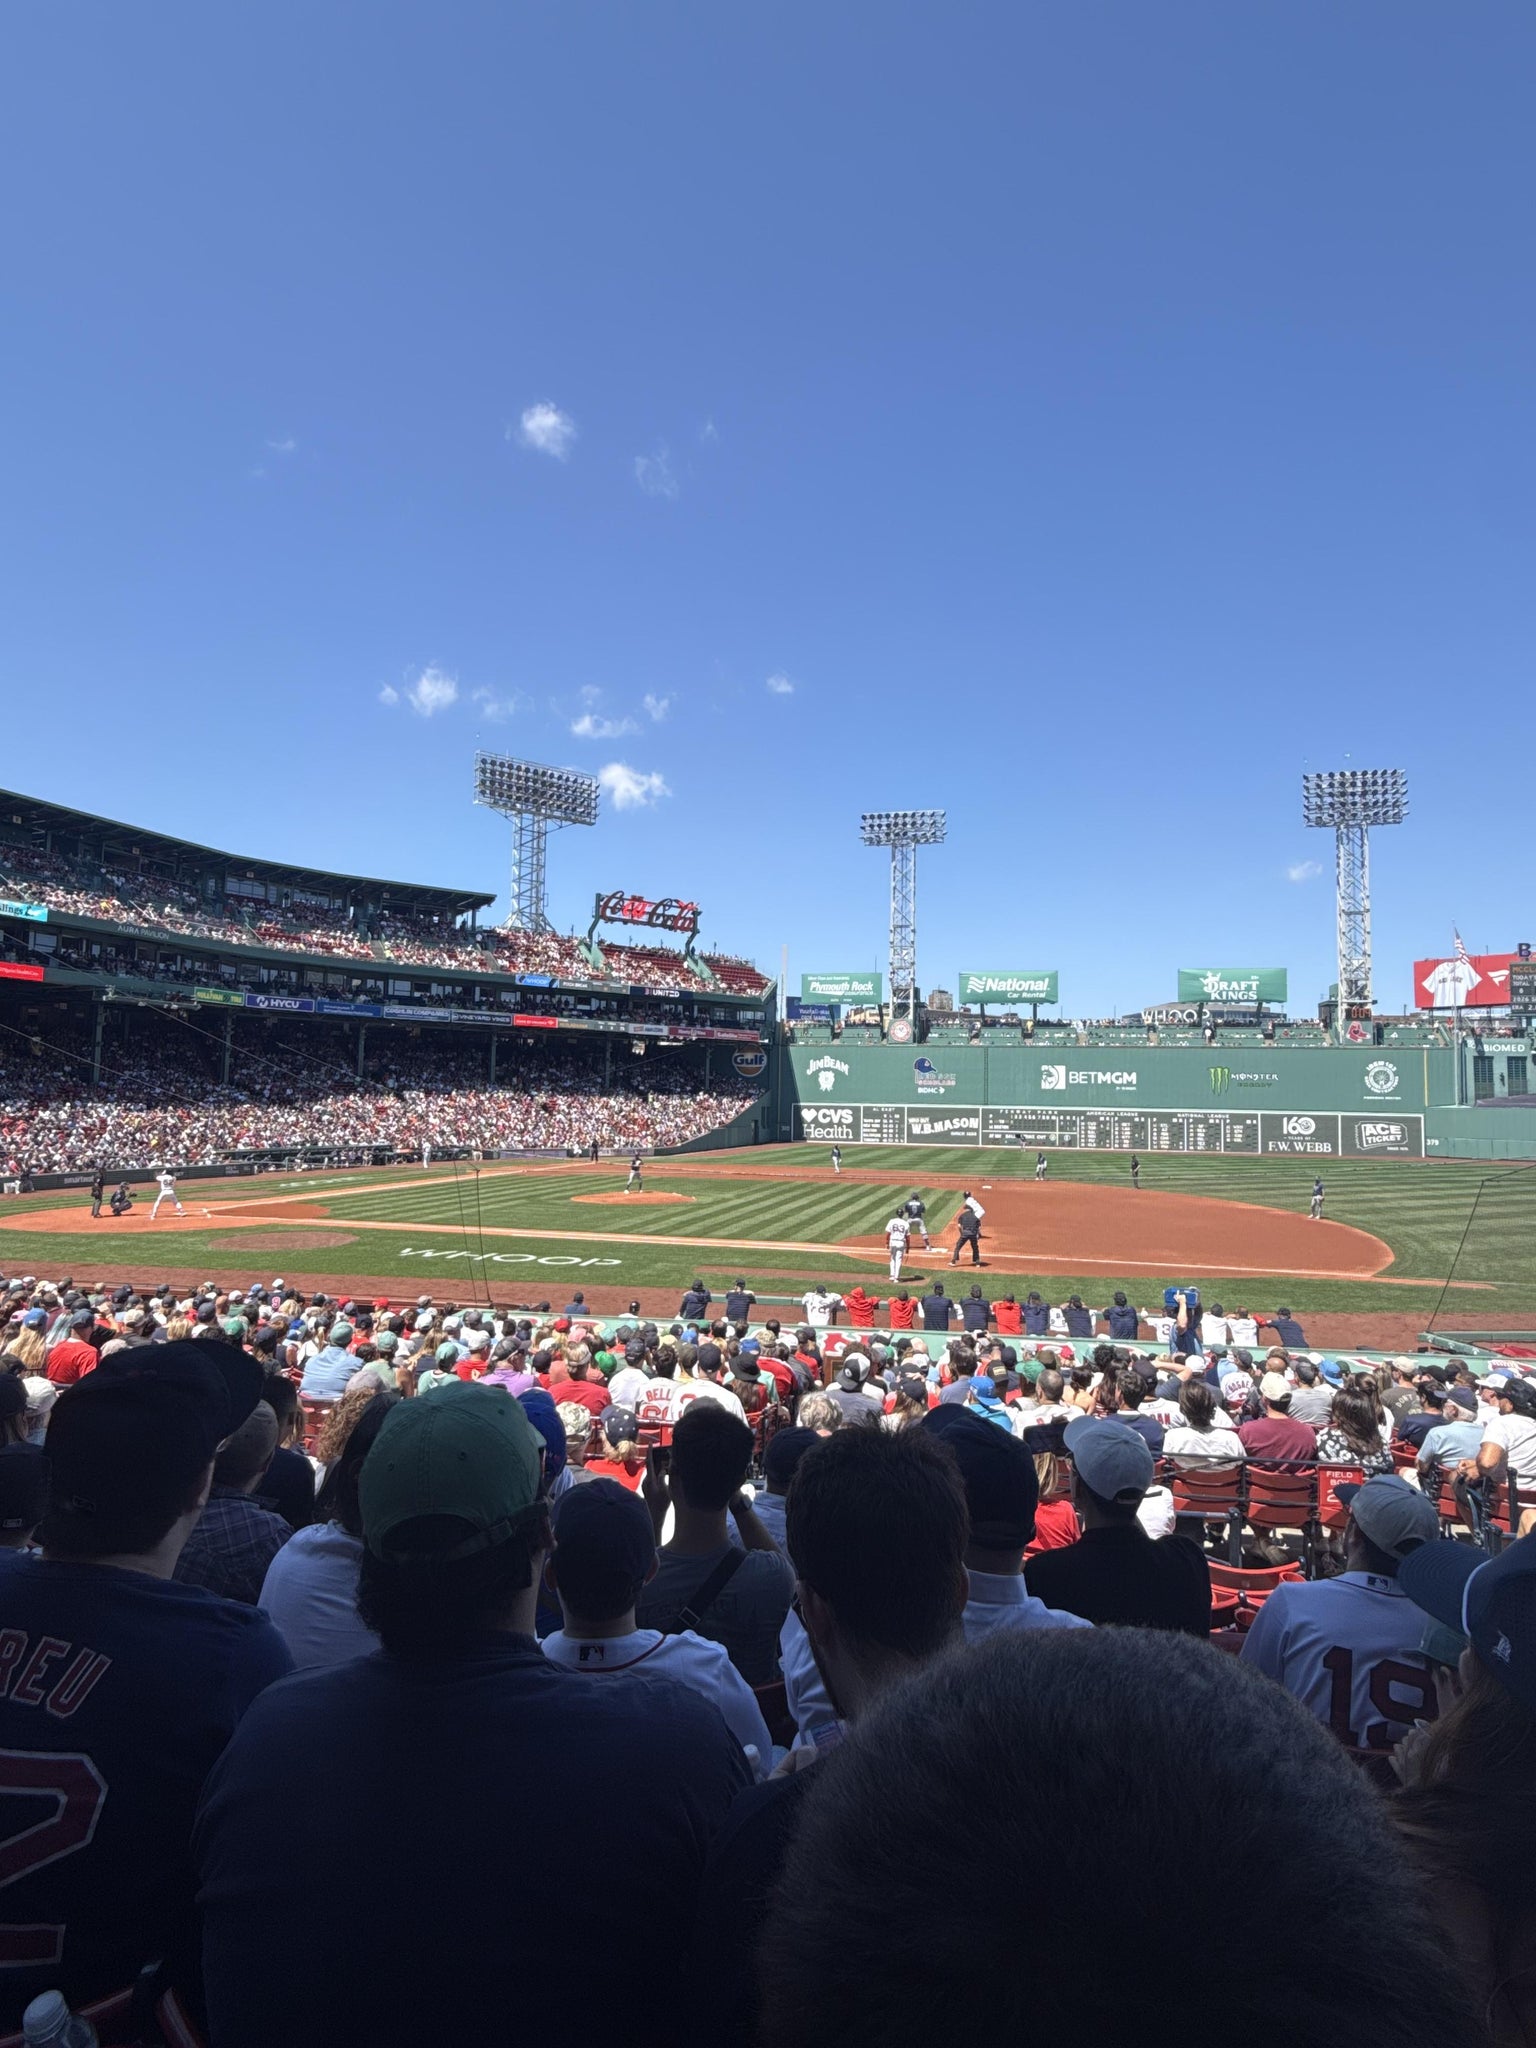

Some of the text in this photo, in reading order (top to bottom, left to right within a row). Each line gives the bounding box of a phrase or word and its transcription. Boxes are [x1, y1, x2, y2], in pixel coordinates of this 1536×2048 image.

[601, 890, 697, 932] Coca-Cola
[810, 981, 873, 992] Plymouth Rock
[985, 977, 1049, 991] National
[1203, 981, 1259, 993] DRAFT
[652, 990, 680, 998] UNITED
[1210, 991, 1257, 1000] KINGS
[270, 999, 299, 1008] HYCU
[1140, 1009, 1210, 1023] WHOOP
[732, 1052, 767, 1066] Gulf
[823, 1056, 849, 1075] BEAM
[1069, 1071, 1137, 1085] BETMGM
[1231, 1072, 1279, 1081] MONSTER
[818, 1108, 853, 1124] CVS
[803, 1124, 853, 1139] Health
[1282, 1116, 1316, 1135] 160
[1365, 1123, 1402, 1136] ACE
[1366, 1134, 1402, 1144] TICKET
[1268, 1141, 1332, 1152] F.W. WEBB
[399, 1247, 621, 1267] WHOOP
[1326, 1470, 1354, 1478] FIELD
